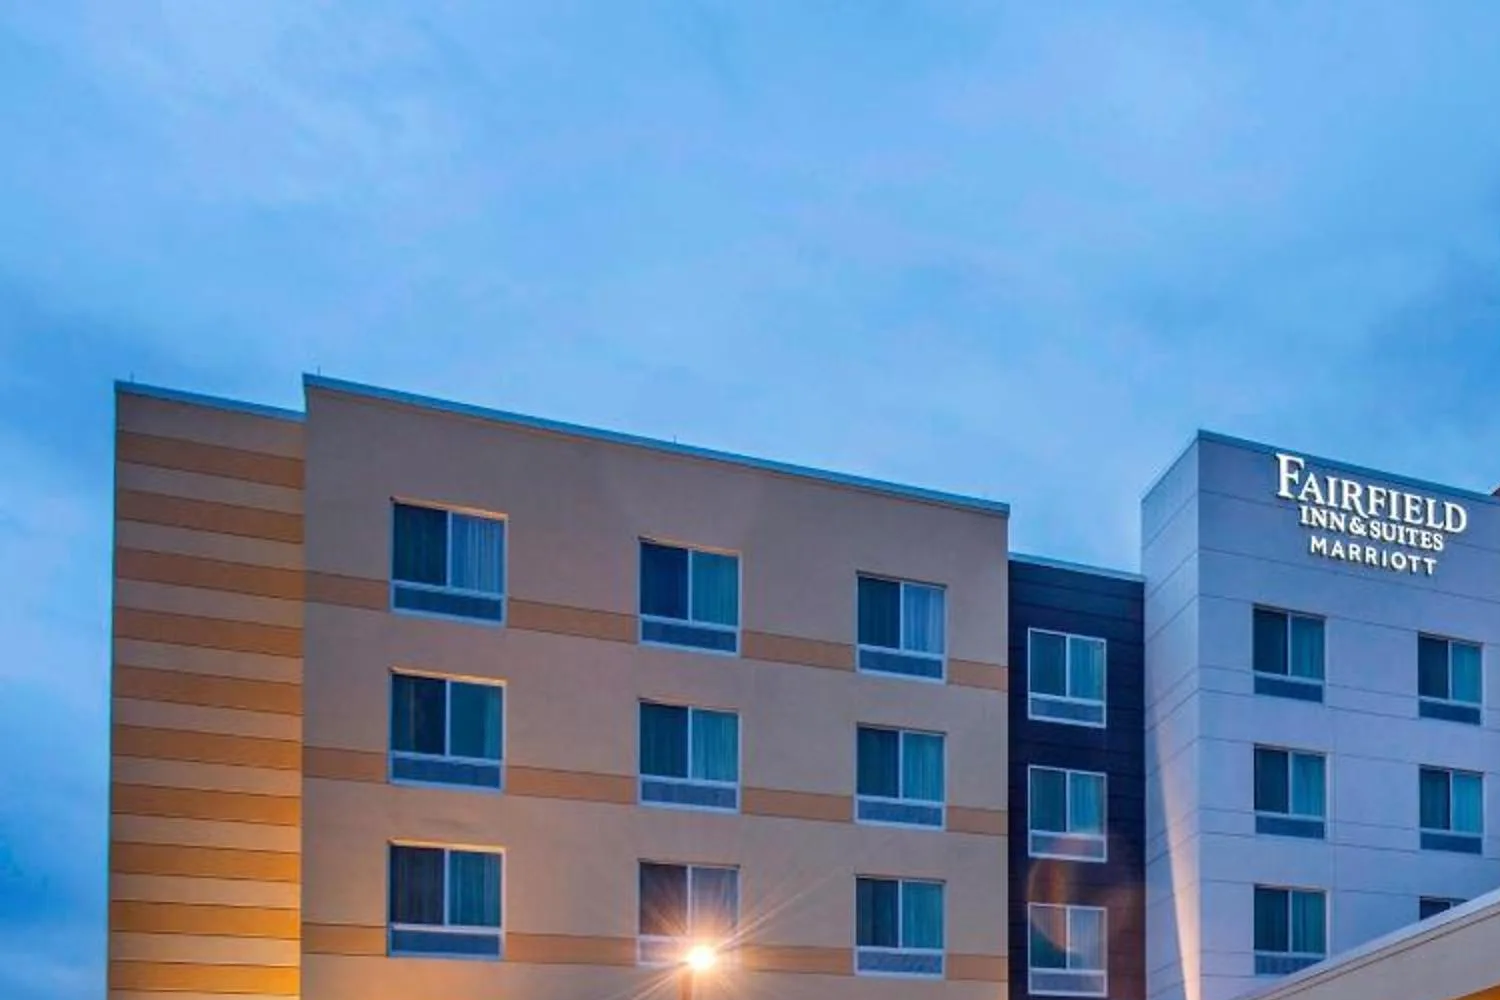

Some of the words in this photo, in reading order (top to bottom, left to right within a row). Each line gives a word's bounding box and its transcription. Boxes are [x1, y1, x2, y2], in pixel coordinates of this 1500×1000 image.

[1275, 453, 1467, 533] FAIRFIELD
[1300, 505, 1345, 533] INN
[1349, 515, 1366, 536] &
[1369, 520, 1444, 551] SUITES
[1310, 536, 1437, 575] MARRIOTT
